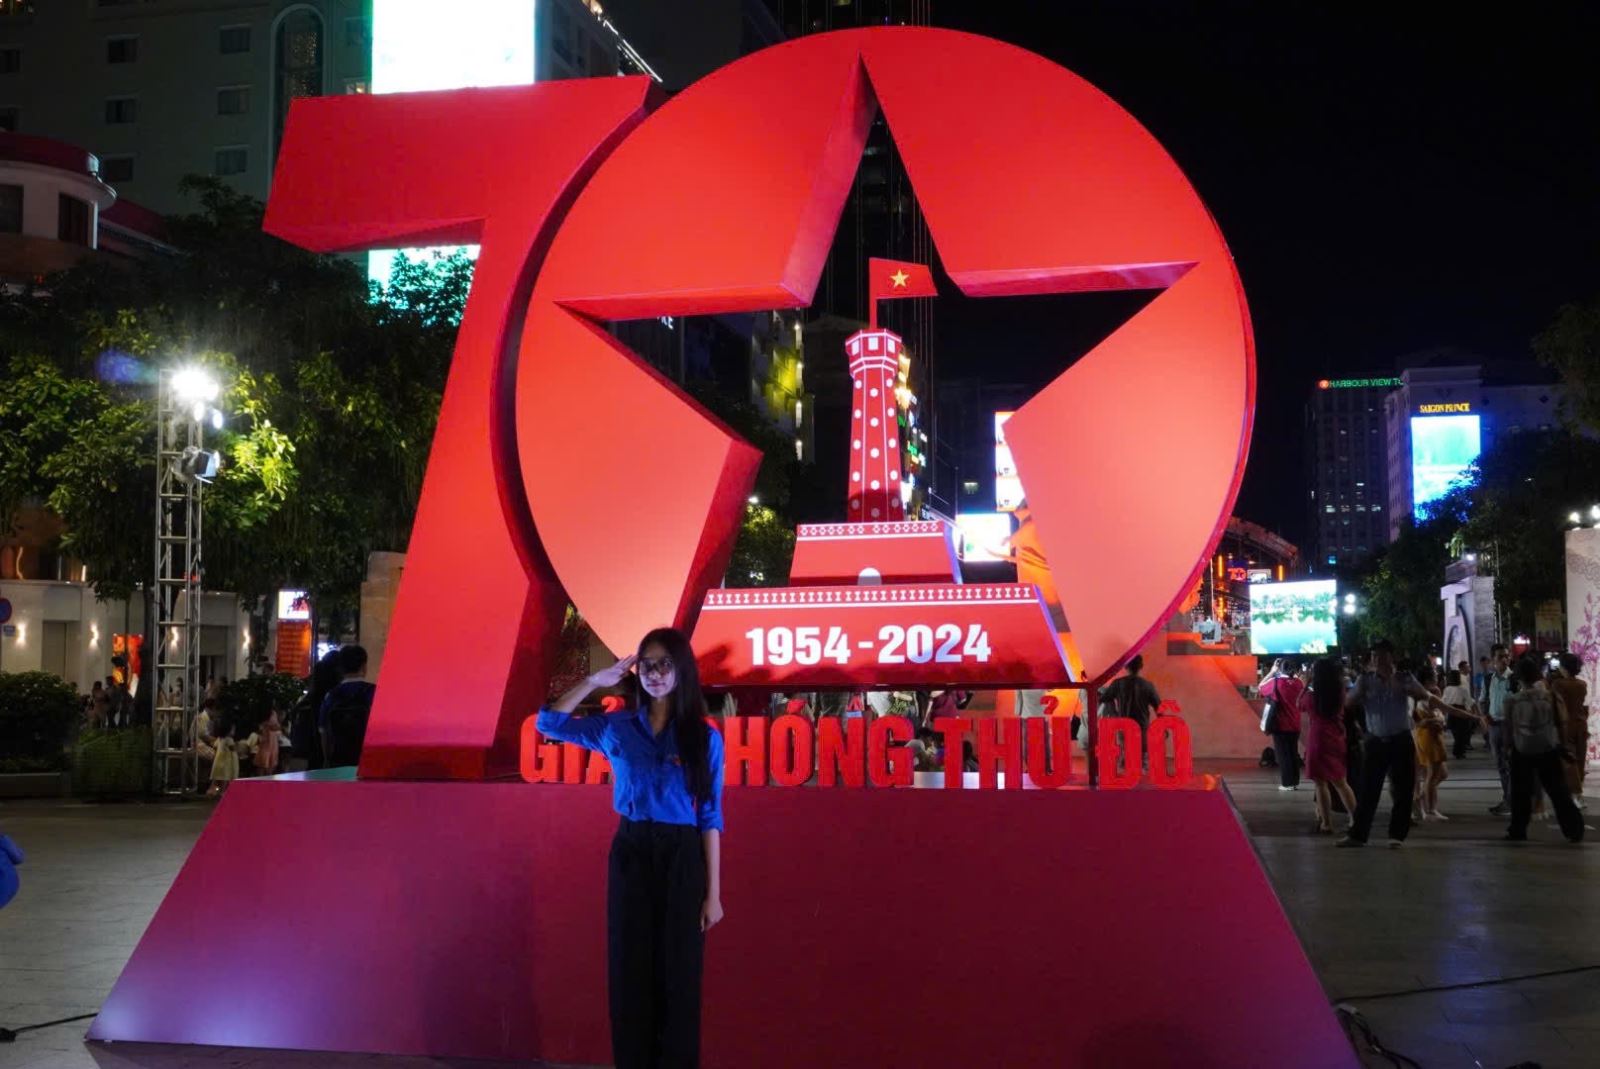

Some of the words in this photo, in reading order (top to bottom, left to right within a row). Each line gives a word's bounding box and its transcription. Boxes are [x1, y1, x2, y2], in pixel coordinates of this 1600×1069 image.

[1329, 379, 1369, 388] HARBOUR
[1370, 378, 1392, 387] VIEW
[704, 698, 914, 788] HÓNG
[934, 695, 1073, 790] THỦ
[1096, 699, 1193, 790] ĐÔ
